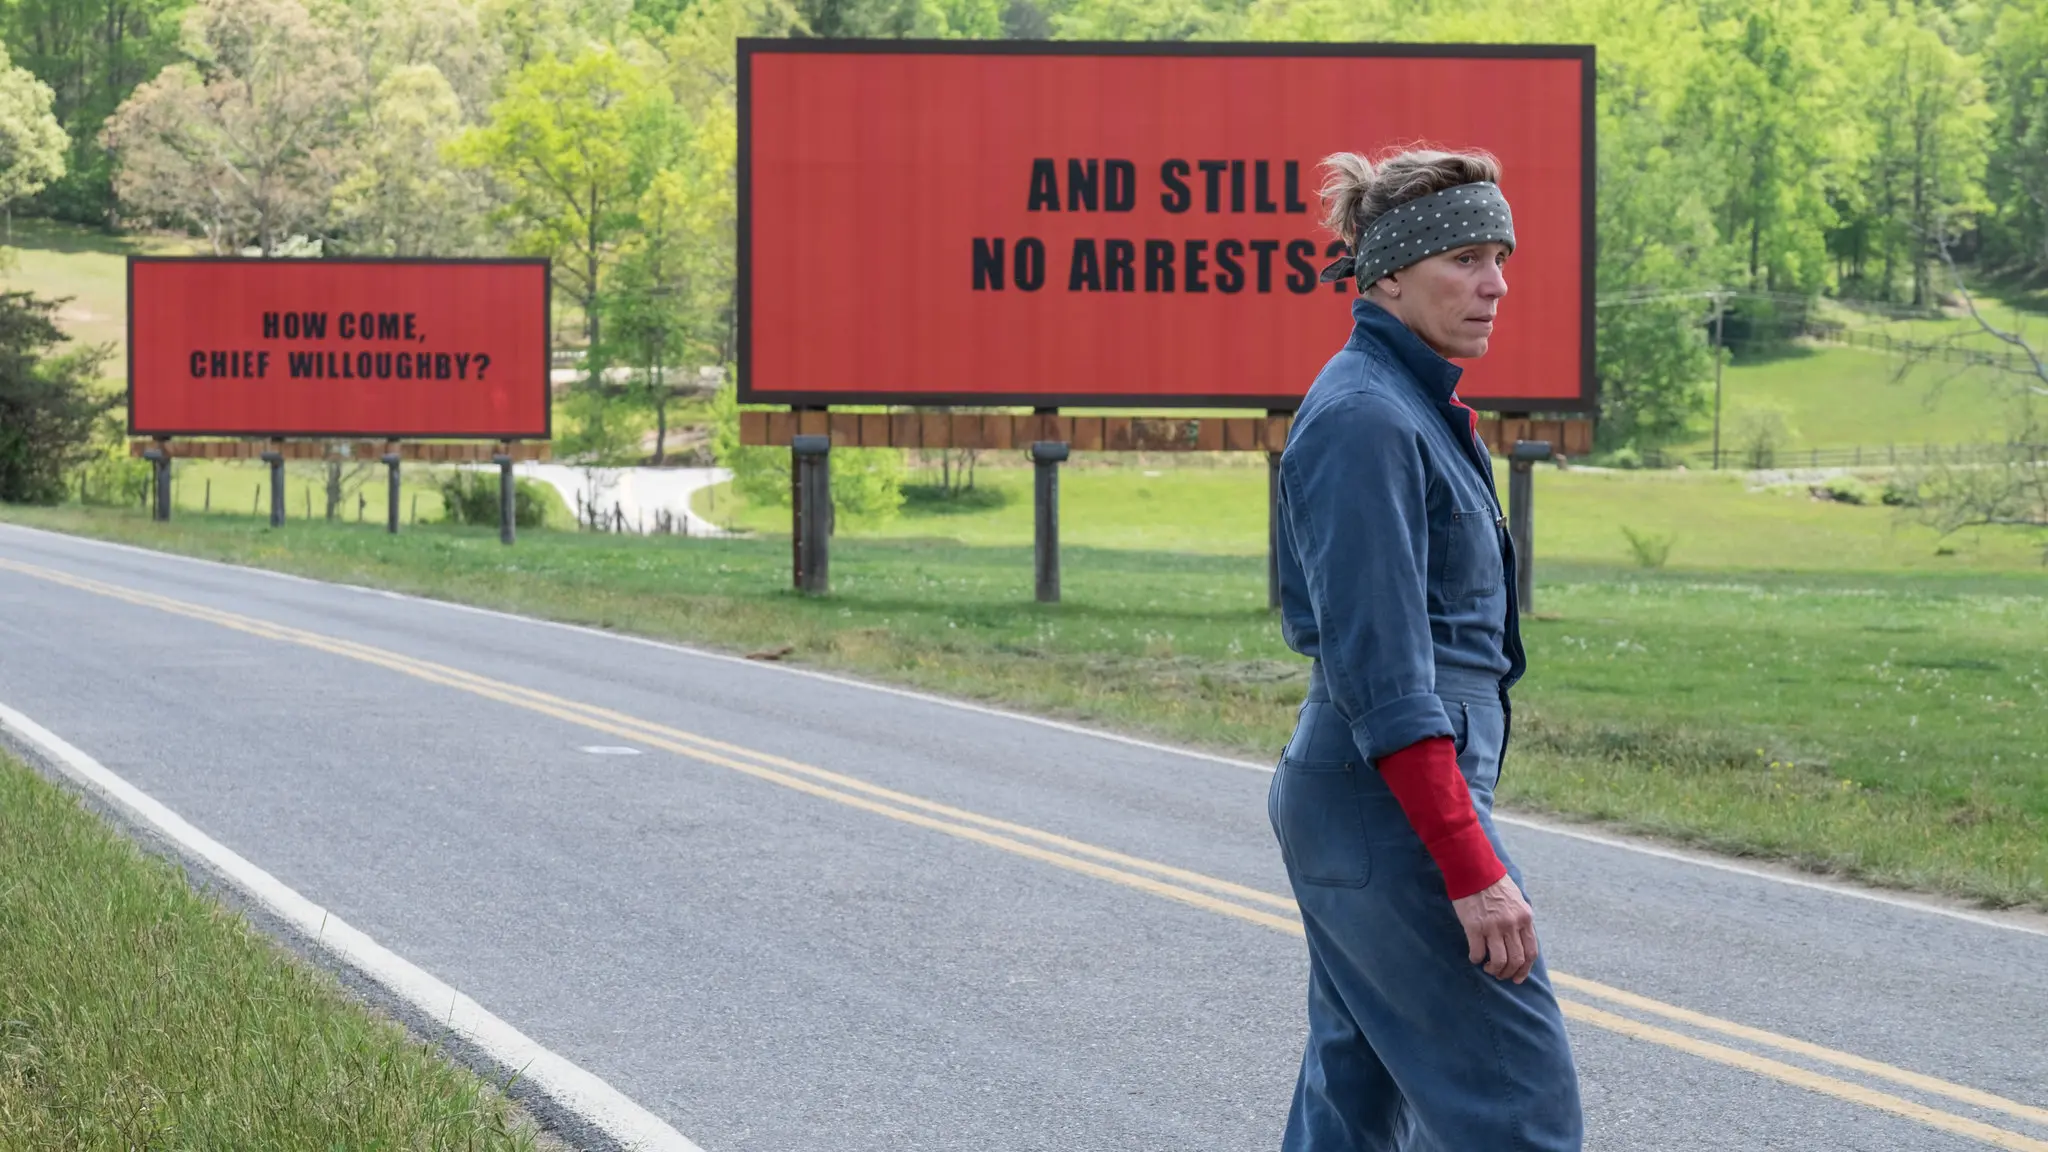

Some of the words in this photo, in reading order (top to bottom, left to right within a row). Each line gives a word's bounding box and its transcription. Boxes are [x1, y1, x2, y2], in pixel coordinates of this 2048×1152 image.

[1027, 157, 1137, 213] AND
[1160, 158, 1308, 215] STILL
[971, 236, 1046, 292] NO
[262, 311, 328, 340] HOW
[338, 312, 426, 345] COME,
[189, 350, 270, 379] CHIEF
[287, 351, 492, 381] WILLOUGHBY?
